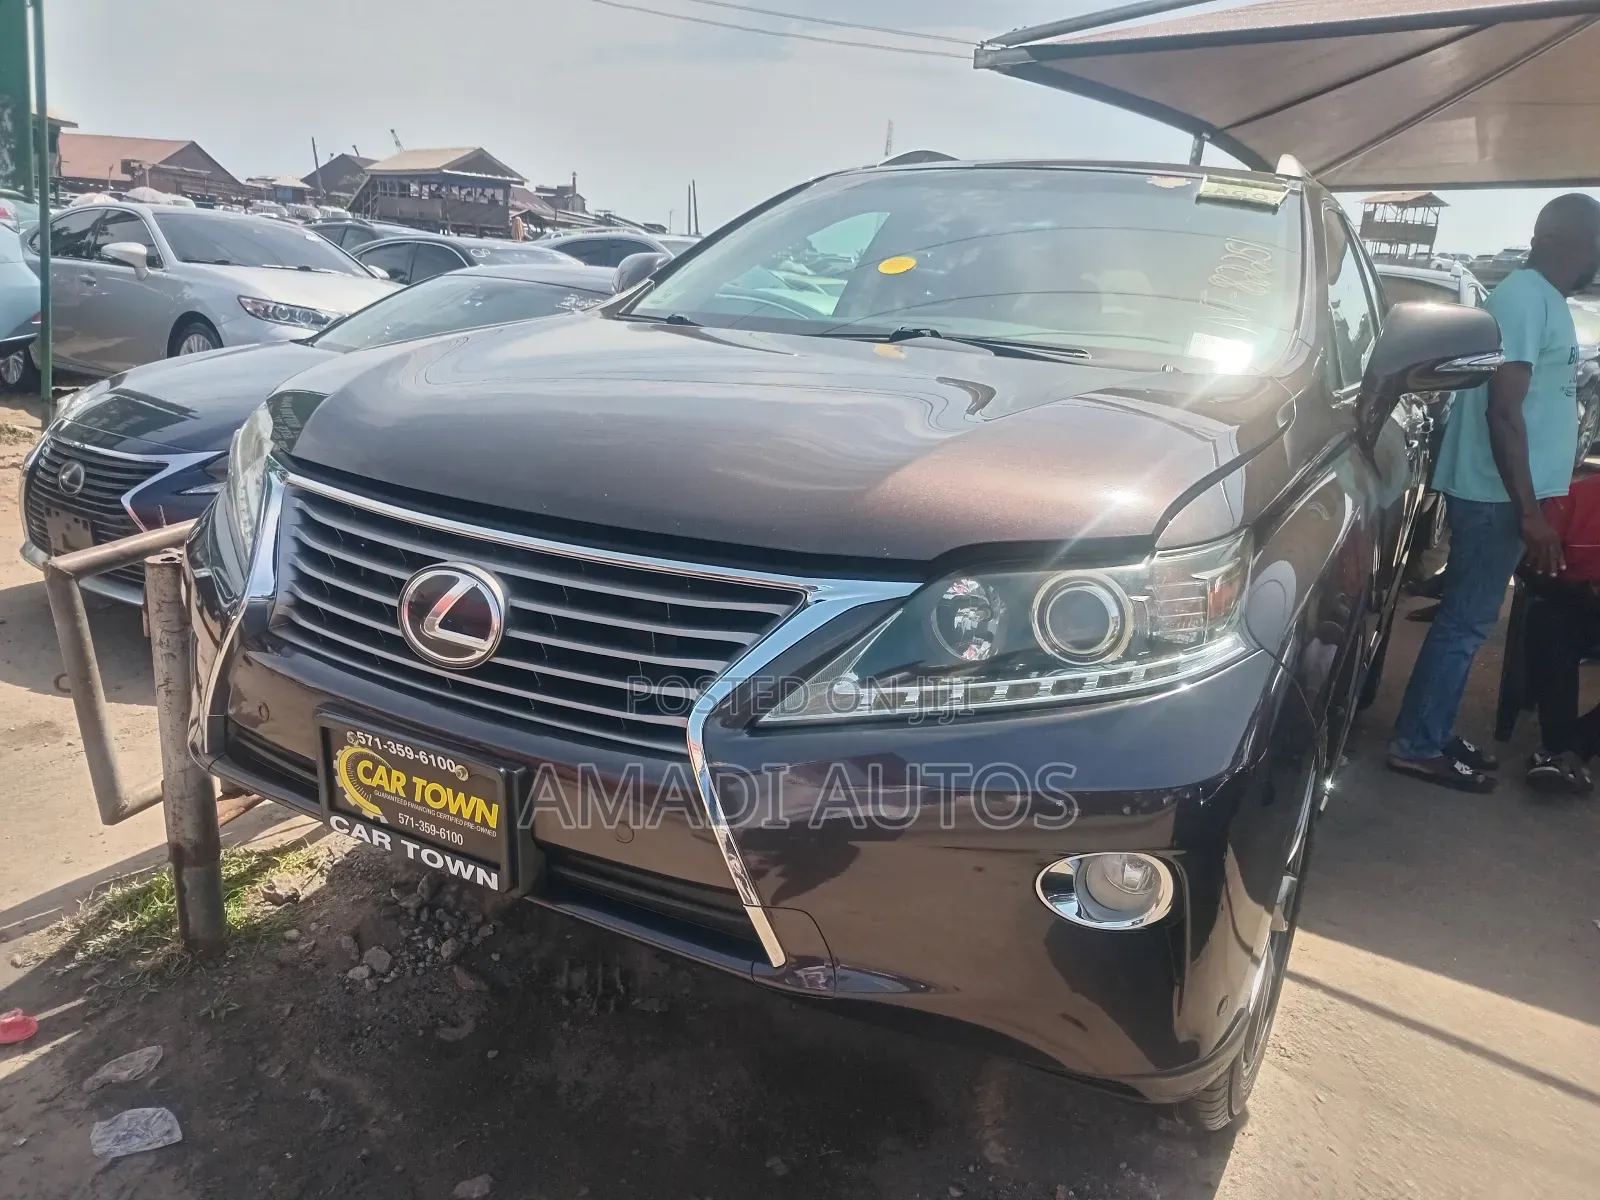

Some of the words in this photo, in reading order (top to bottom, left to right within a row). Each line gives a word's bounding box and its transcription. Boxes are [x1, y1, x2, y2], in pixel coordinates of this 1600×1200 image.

[356, 731, 456, 772] 571-359-6100
[356, 759, 407, 798] CAR
[412, 776, 499, 829] TOWN
[373, 789, 408, 807] GUARANTEED
[407, 802, 436, 817] FINANCING
[436, 811, 464, 827] CERTIFIED
[463, 821, 497, 838] PRE-OWNED
[329, 815, 392, 851] CAR
[401, 839, 499, 891] TOWN
[398, 812, 464, 846] 571-359-6100
